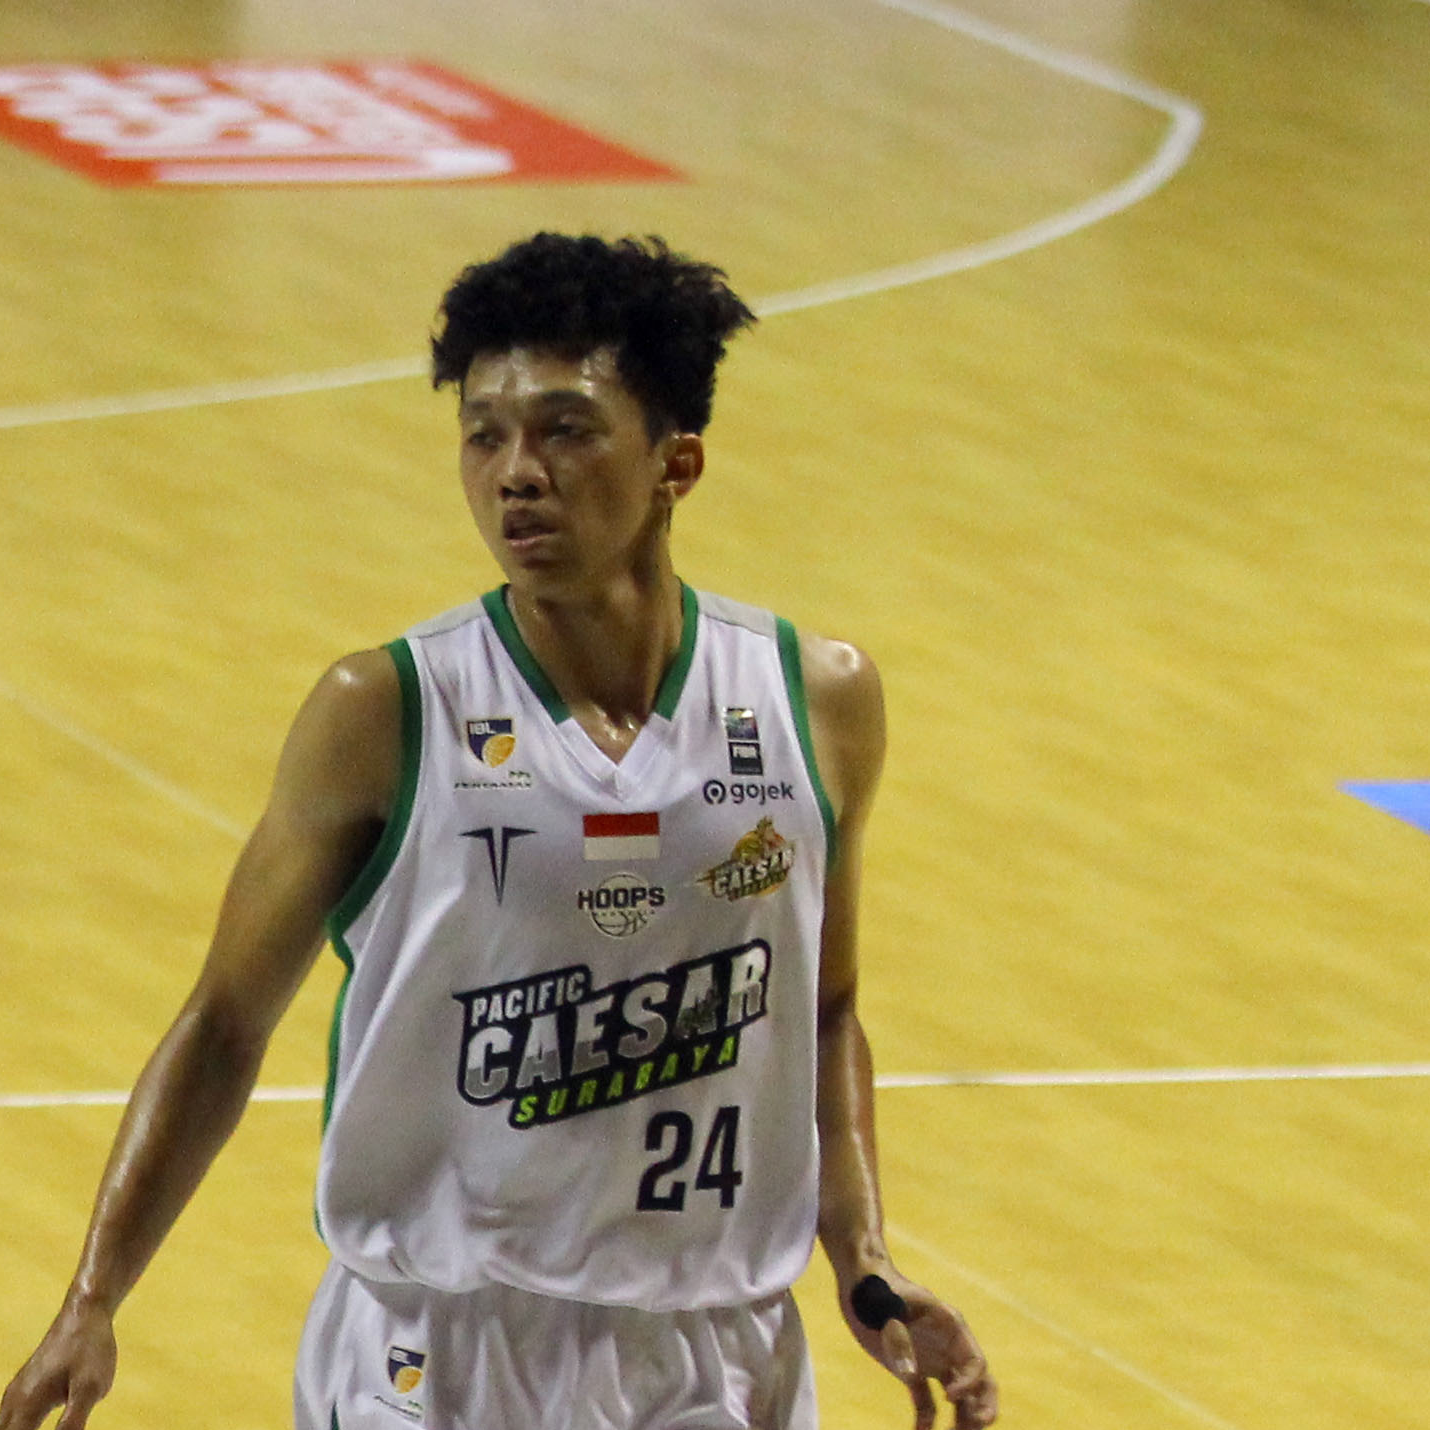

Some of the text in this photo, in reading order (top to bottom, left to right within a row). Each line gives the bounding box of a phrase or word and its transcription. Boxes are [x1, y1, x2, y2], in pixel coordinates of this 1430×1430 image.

[731, 781, 794, 805] gojek
[577, 886, 666, 910] HOOPS
[465, 946, 763, 1100] CAESAR
[471, 971, 586, 1027] PACIFIC
[514, 1036, 737, 1124] SURABAYA
[636, 1105, 743, 1212] 24
